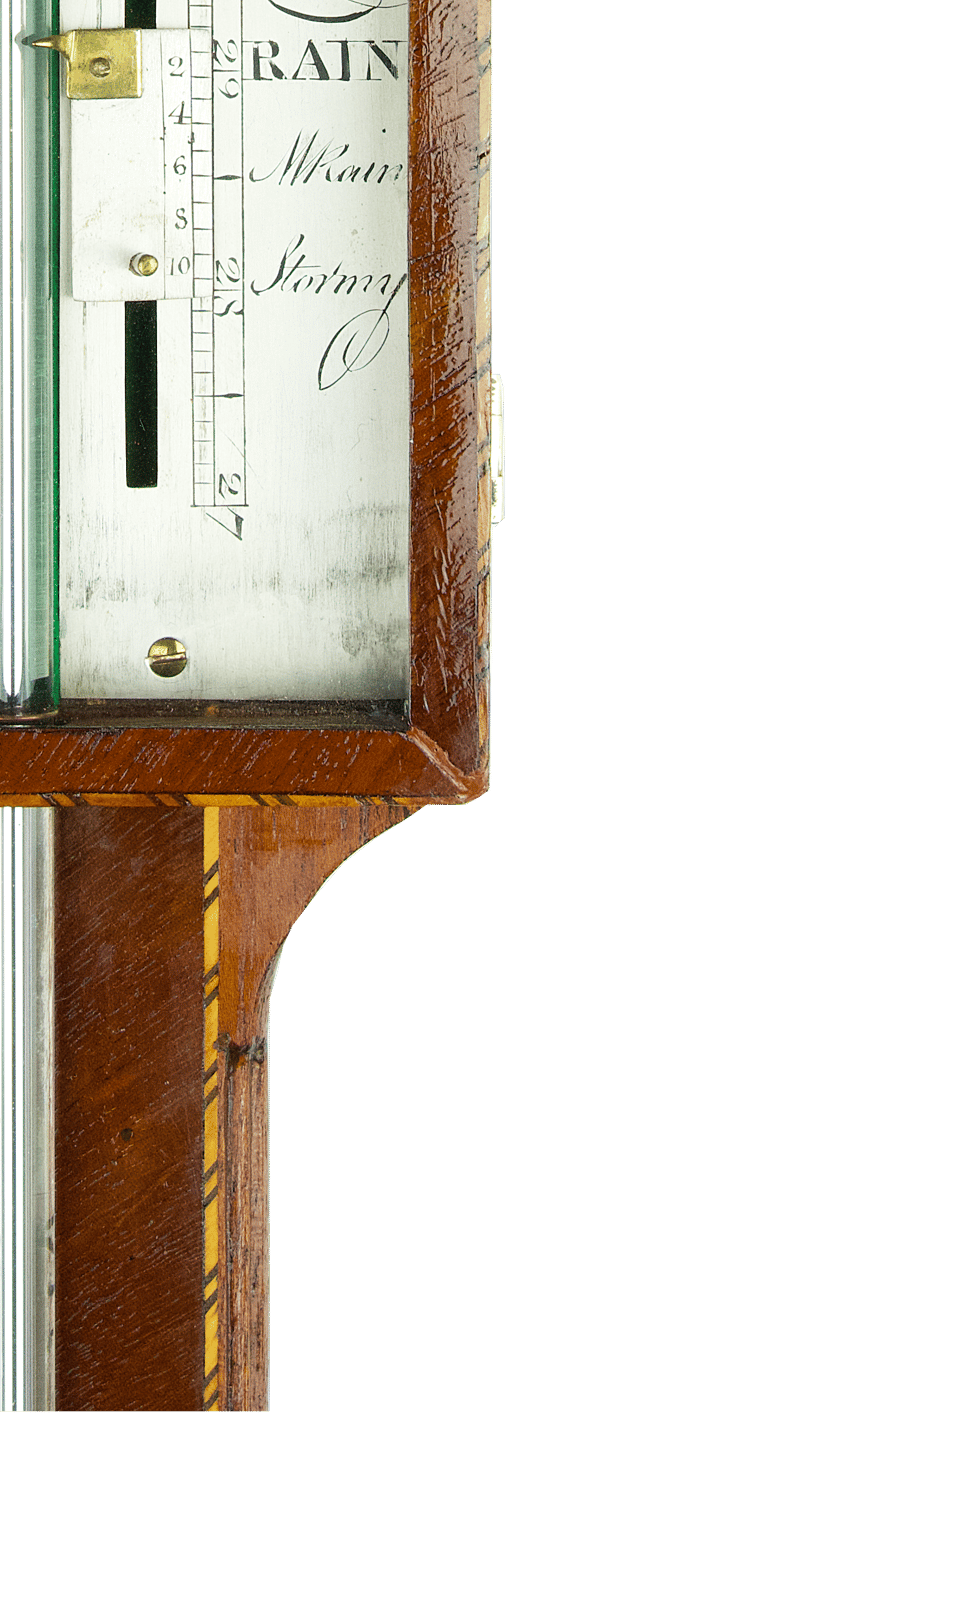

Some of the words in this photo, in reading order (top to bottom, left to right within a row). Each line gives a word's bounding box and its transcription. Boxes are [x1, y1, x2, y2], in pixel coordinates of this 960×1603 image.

[168, 56, 187, 78] 2
[240, 38, 408, 82] RAIN
[167, 101, 191, 125] 4
[172, 155, 187, 176] 6
[174, 207, 189, 230] 8
[167, 255, 191, 276] 10
[250, 233, 408, 391] Stormy
